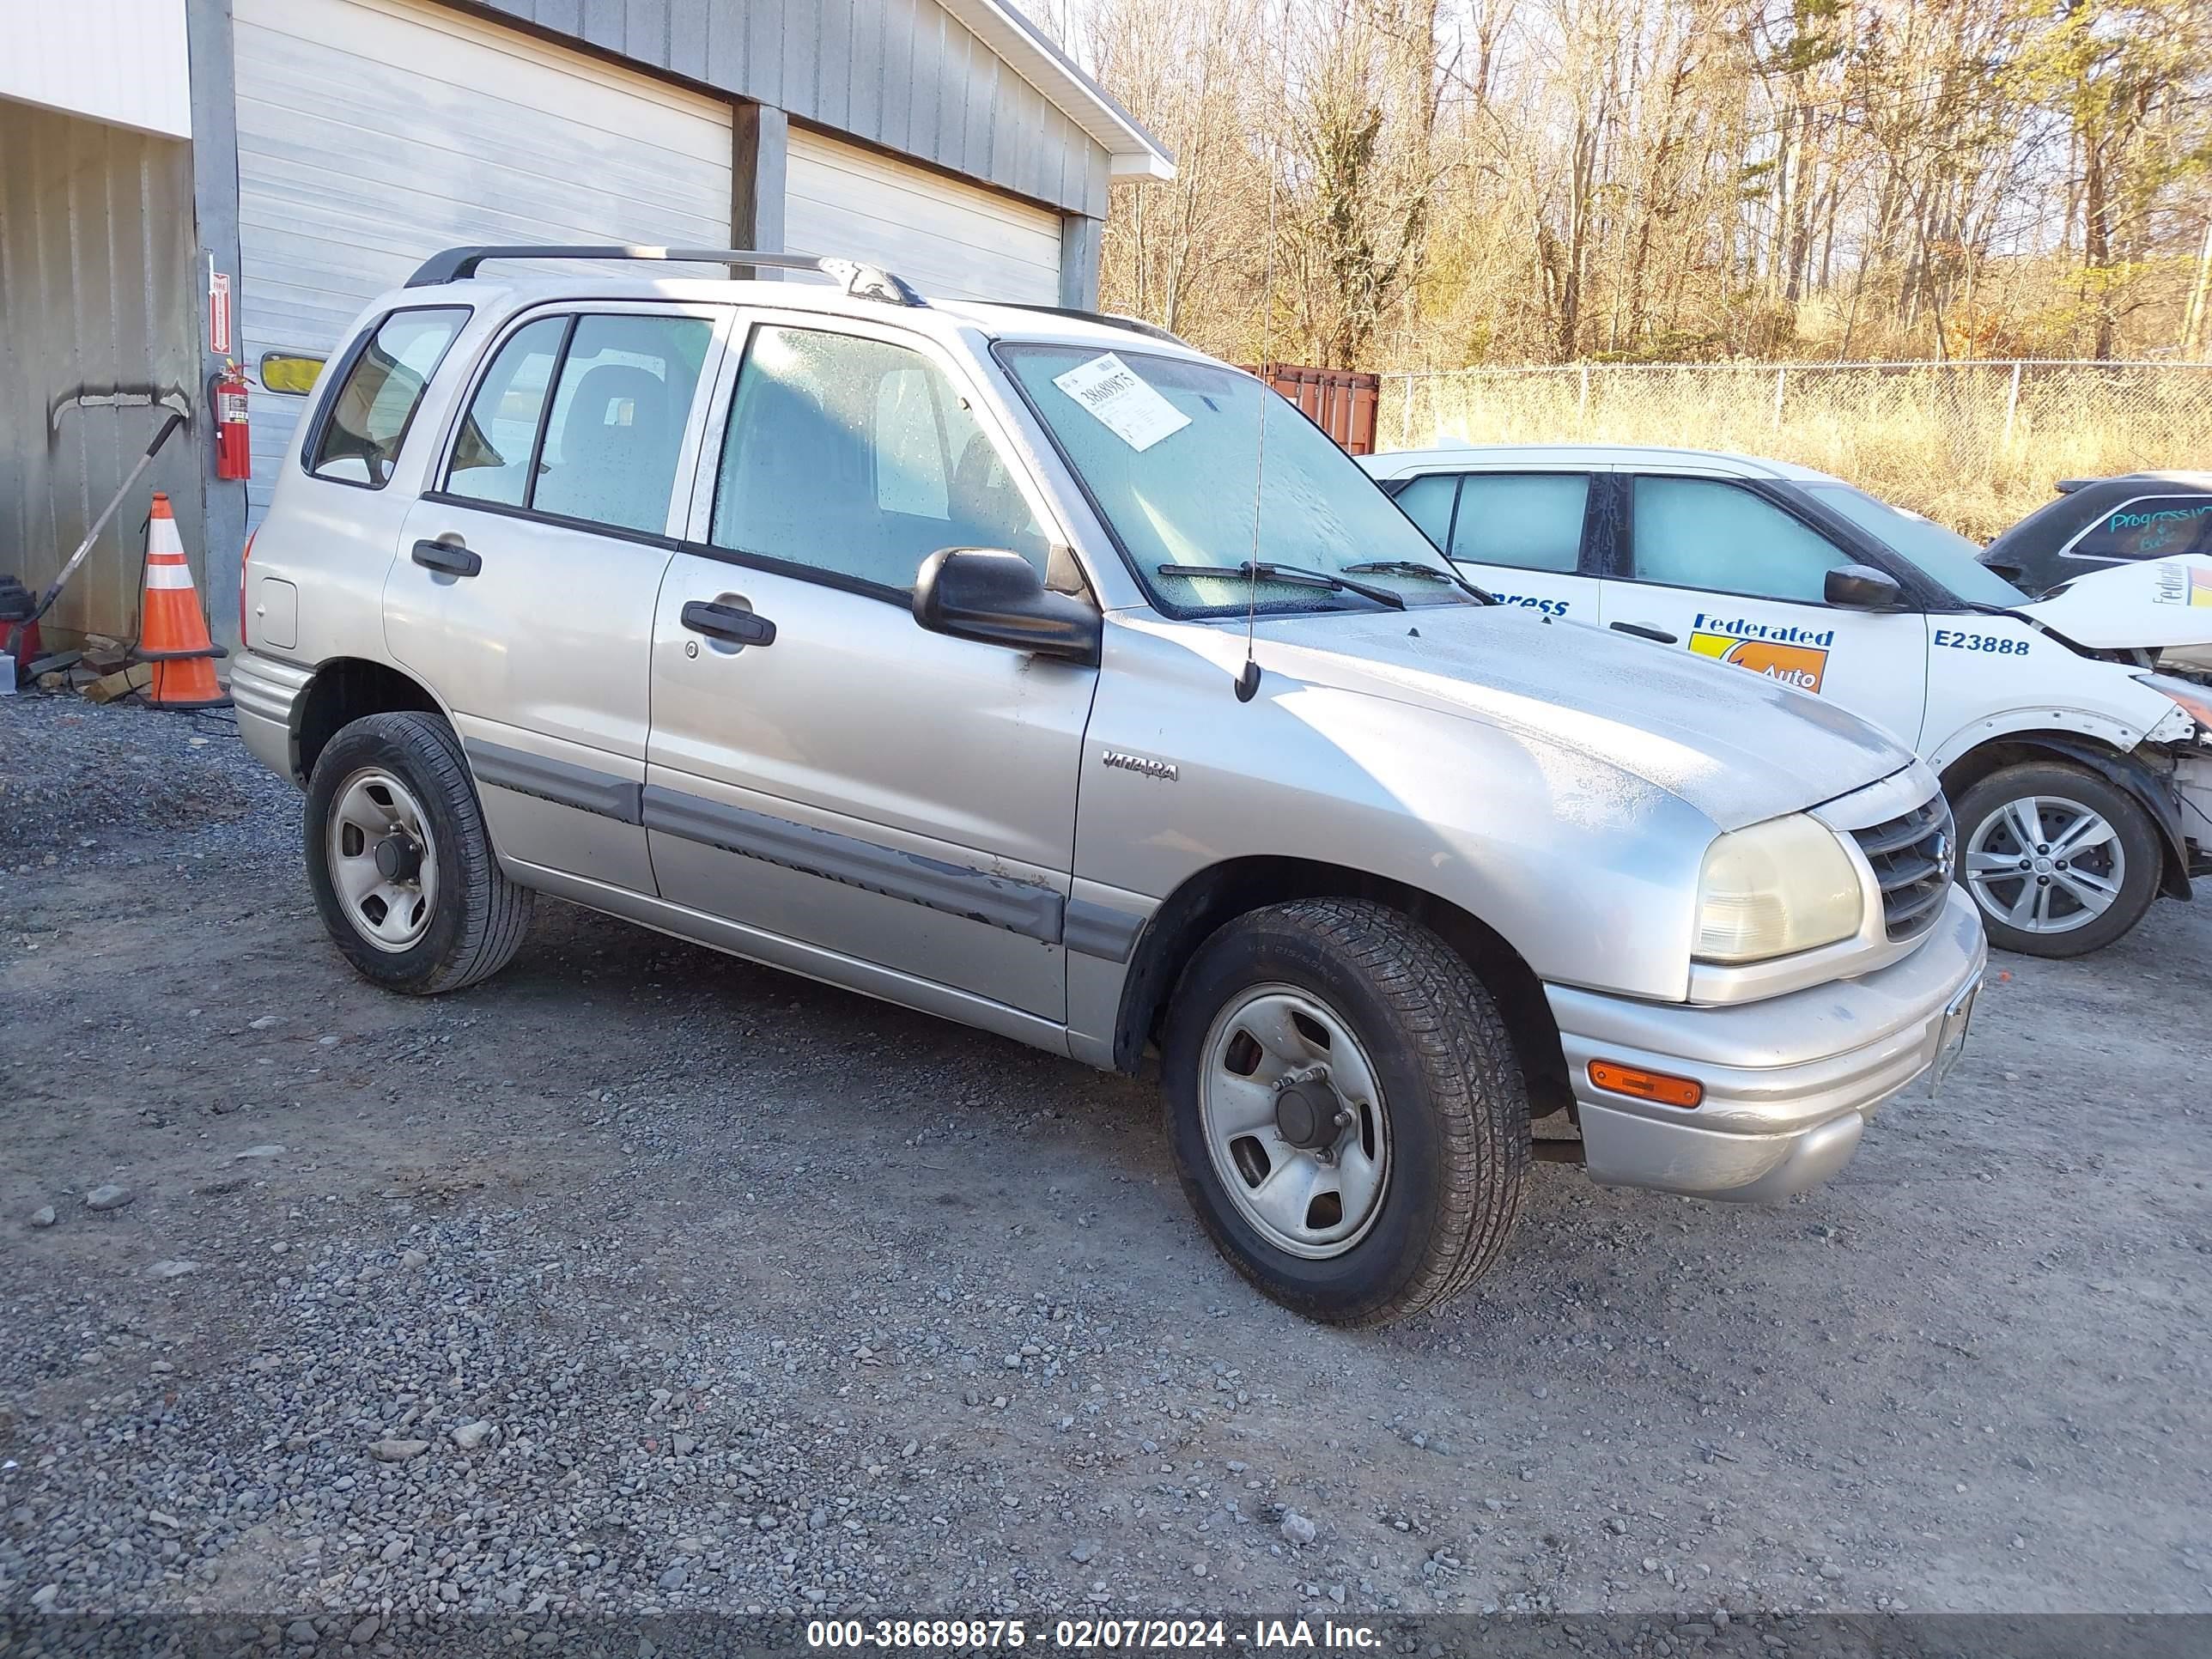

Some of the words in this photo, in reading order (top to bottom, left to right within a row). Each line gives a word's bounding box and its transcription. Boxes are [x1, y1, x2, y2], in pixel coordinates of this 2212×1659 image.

[213, 282, 227, 290] FIRE
[1080, 372, 1135, 406] 38689875
[1693, 613, 1834, 647] Federated
[1934, 629, 2030, 655] E23888
[1763, 662, 1817, 688] Auto
[1103, 750, 1178, 781] VITARA
